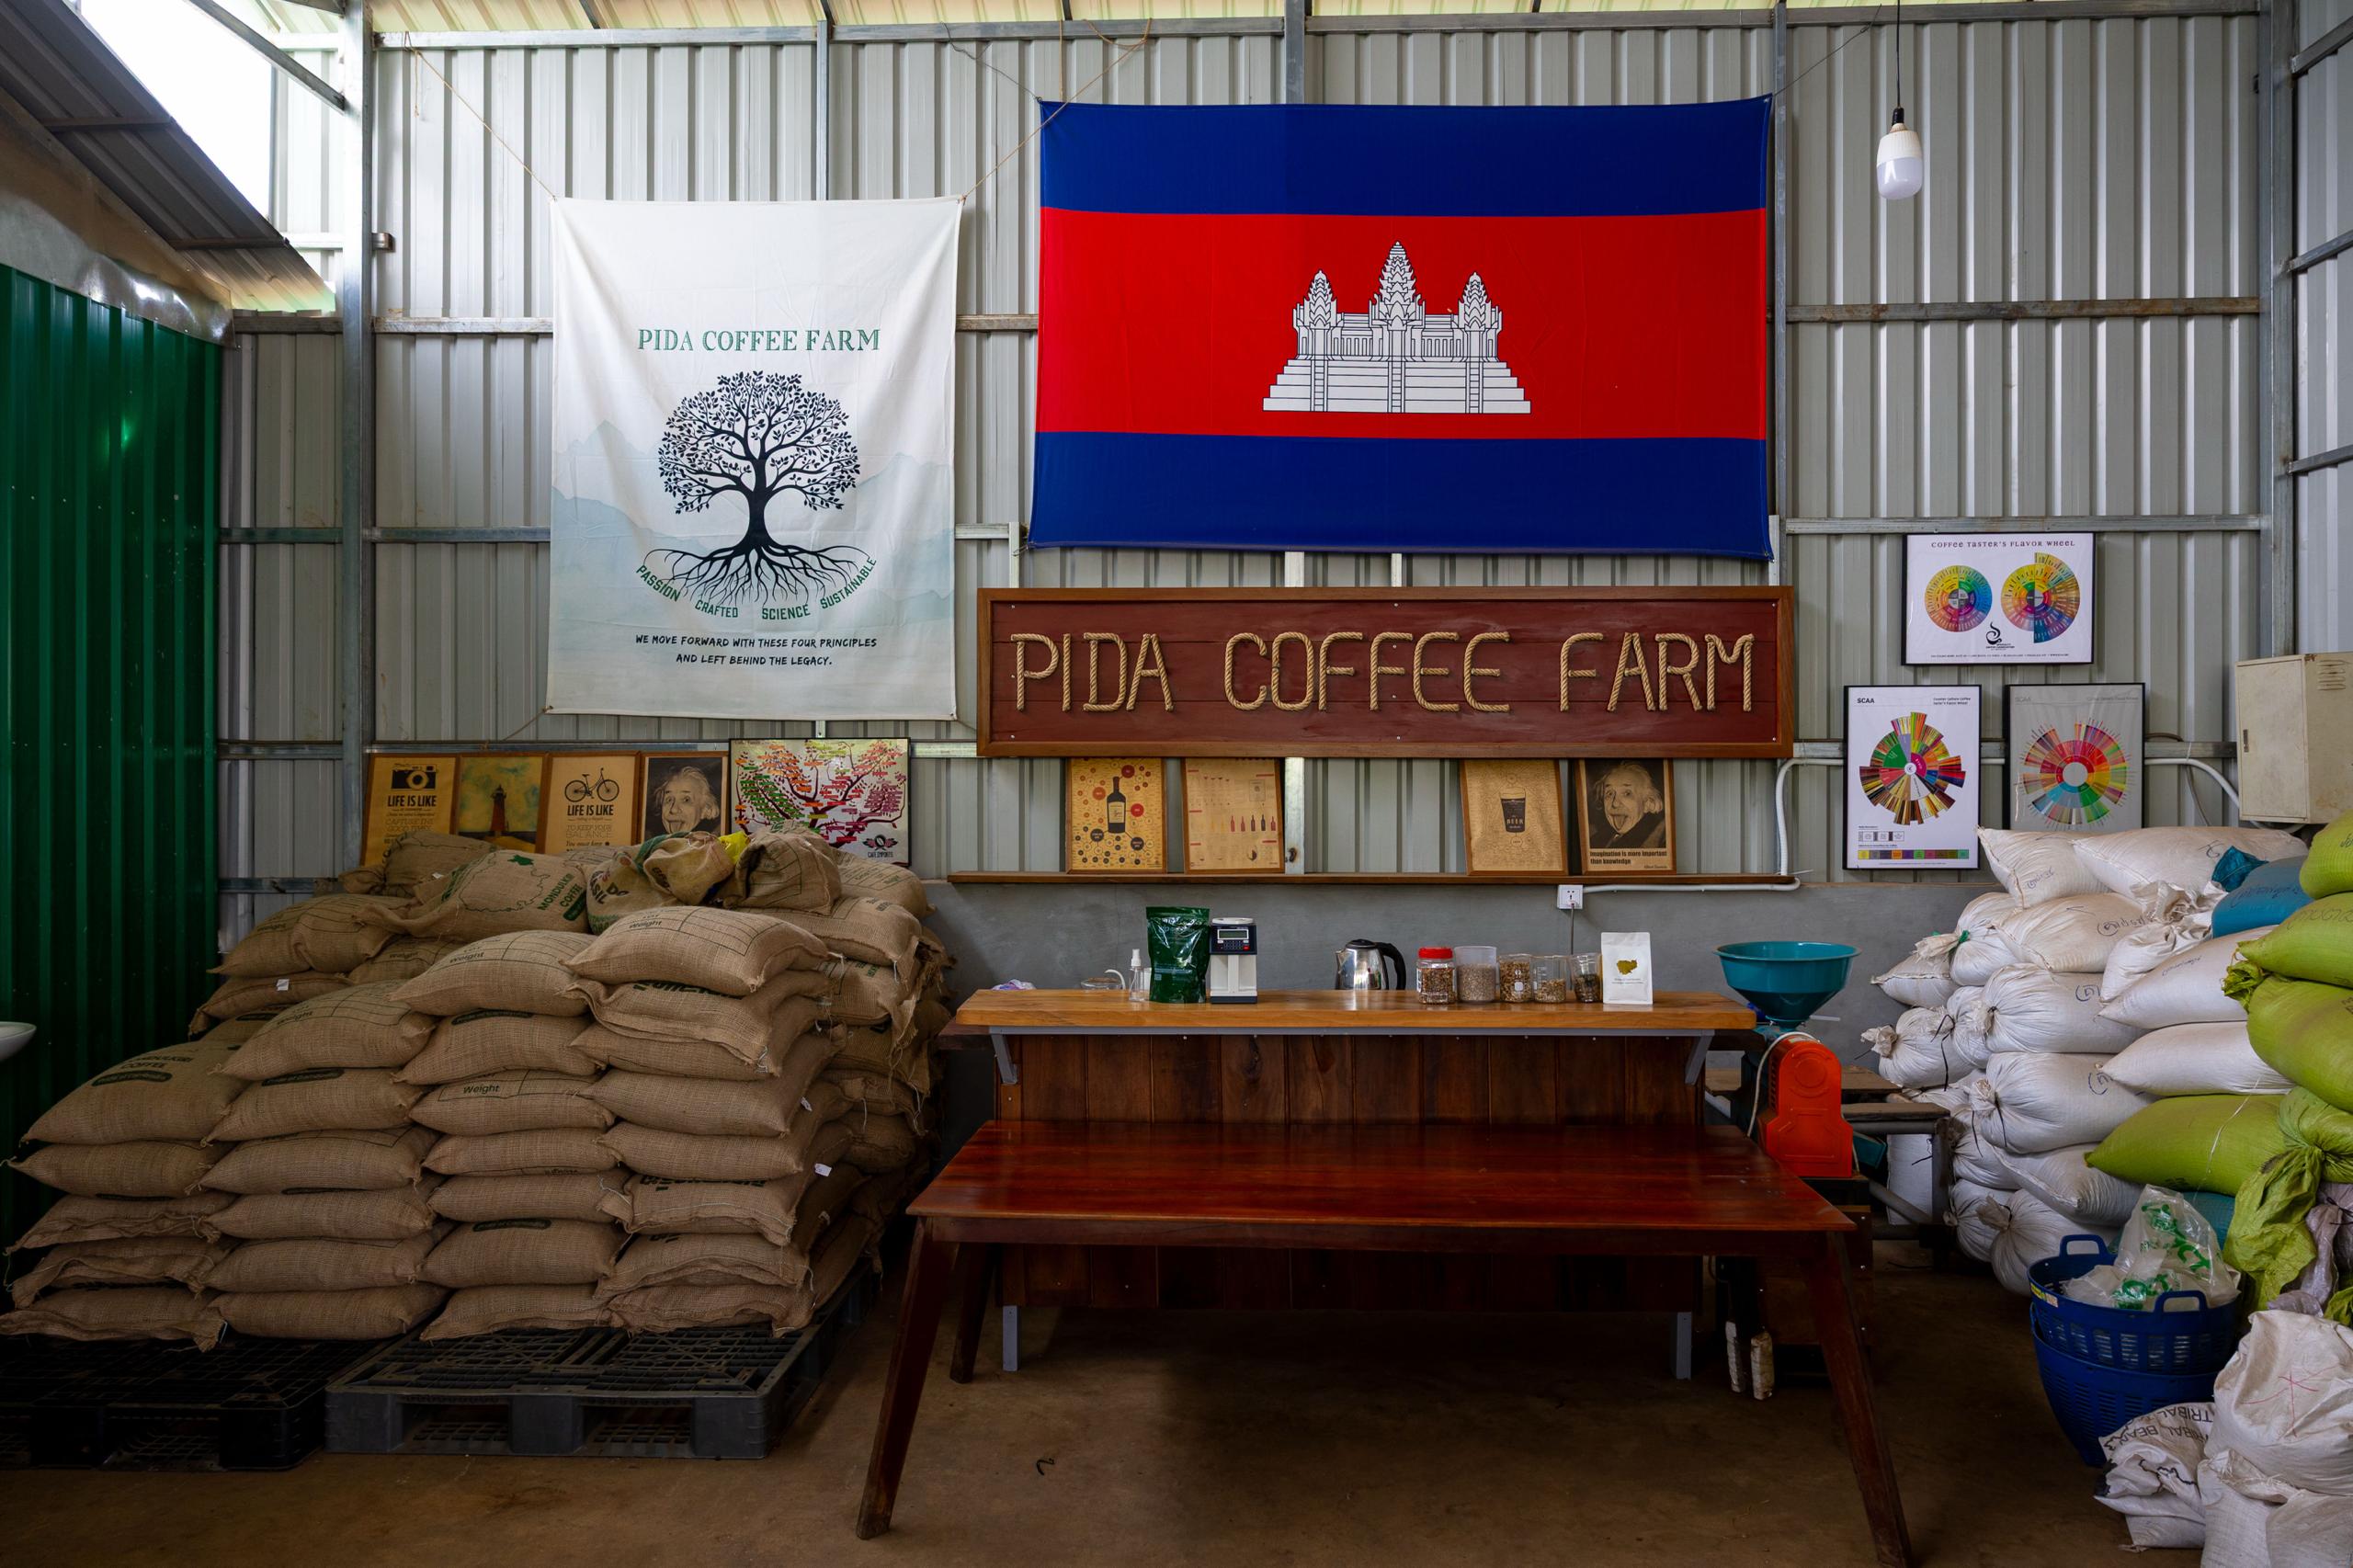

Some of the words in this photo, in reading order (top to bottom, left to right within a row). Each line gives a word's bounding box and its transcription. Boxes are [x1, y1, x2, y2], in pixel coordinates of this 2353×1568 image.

[638, 329, 694, 351] PIDA
[701, 329, 798, 351] COFFEE
[805, 329, 881, 351] FARM
[636, 565, 680, 602] PASSION
[820, 557, 877, 609] SUSTAINABLE
[695, 599, 739, 619] CRAFTED
[761, 604, 811, 620] SCIENCE
[635, 634, 649, 644] WE
[652, 635, 677, 645] MOVE
[680, 636, 730, 647] FORWARD
[733, 638, 756, 648] WITH
[757, 638, 789, 648] THESE
[790, 638, 817, 649] FOUR
[819, 638, 878, 649] PRINCIPLES
[676, 653, 698, 664] AND
[700, 654, 726, 665] LEFT
[729, 655, 767, 665] BEHIND
[768, 656, 788, 666] THE
[790, 656, 833, 666] LEGACY.
[1010, 632, 1175, 712] PIDA
[1224, 631, 1510, 711] COFFEE
[1559, 631, 1756, 711] FARM
[387, 795, 405, 807] LIFE
[407, 795, 416, 807] IS
[417, 795, 438, 807] LIKE
[567, 804, 585, 816] LIFE
[585, 804, 595, 816] IS
[596, 804, 614, 816] LIKE
[565, 831, 613, 839] BALANCE
[629, 920, 663, 929] Weight
[449, 951, 484, 963] Weight
[463, 1085, 500, 1095] Weight
[2156, 1406, 2214, 1424] TRIBAL
[2165, 1426, 2209, 1443] RIBAL
